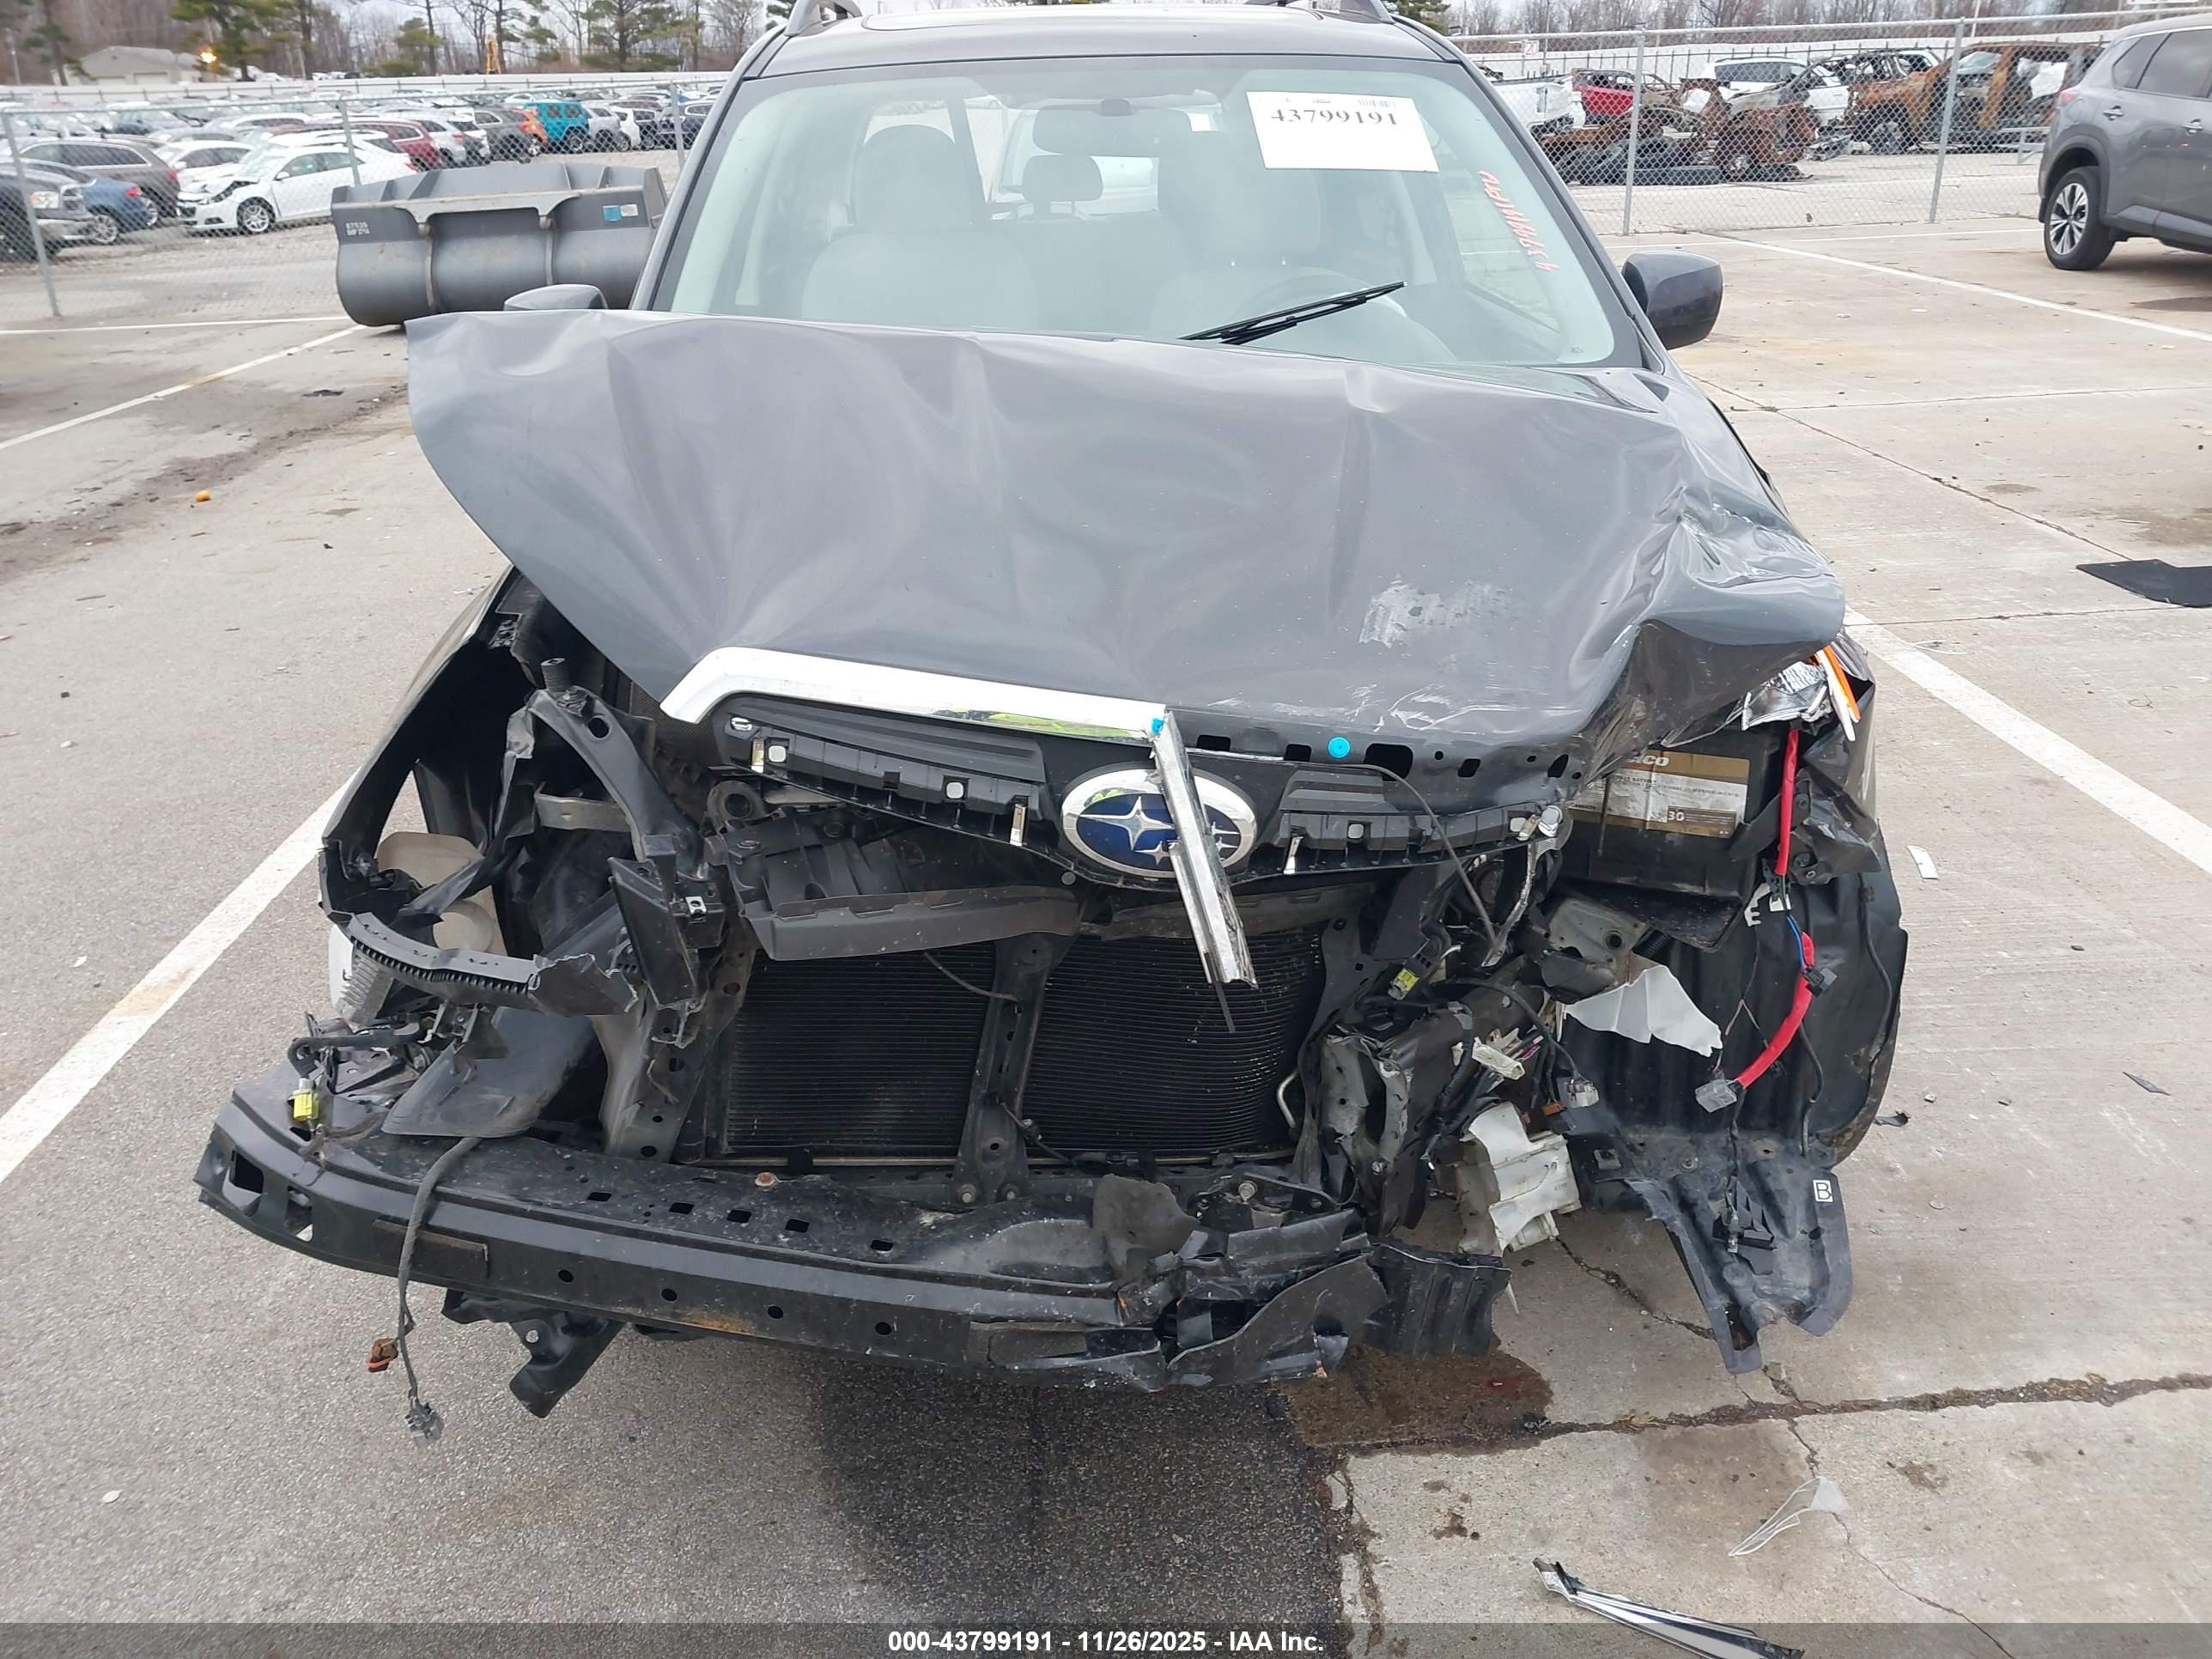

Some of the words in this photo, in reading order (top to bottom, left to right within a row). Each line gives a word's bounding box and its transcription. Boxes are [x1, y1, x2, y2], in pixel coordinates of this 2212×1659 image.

[1271, 108, 1398, 125] 43799191
[1668, 811, 1685, 822] 30
[1815, 1182, 1832, 1200] B
